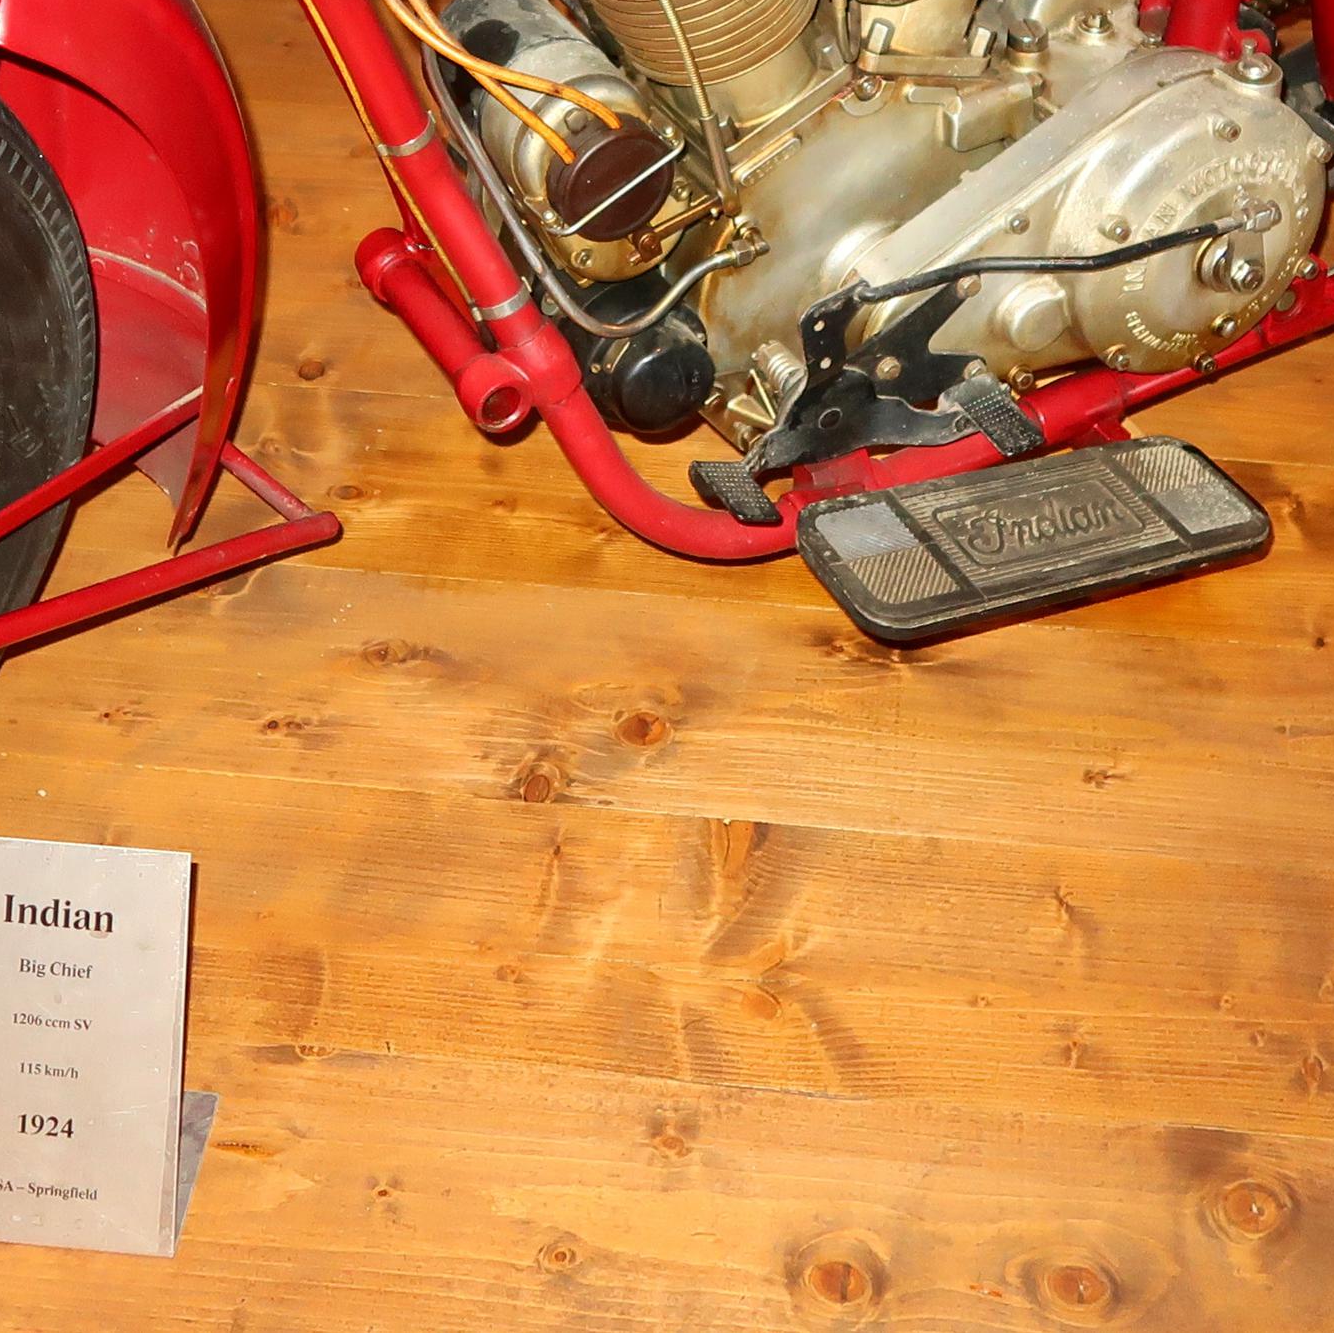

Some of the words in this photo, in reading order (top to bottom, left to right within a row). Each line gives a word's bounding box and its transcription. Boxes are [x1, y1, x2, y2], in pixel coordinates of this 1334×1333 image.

[969, 494, 1127, 555] Indian
[3, 893, 114, 933] Indian
[18, 958, 46, 979] Big
[49, 962, 93, 980] Chief
[11, 1012, 43, 1027] 1206
[44, 1018, 71, 1030] ccm
[73, 1019, 93, 1031] SV
[19, 1062, 41, 1076] 115
[43, 1063, 79, 1080] km/h
[17, 1114, 74, 1139] 1924
[27, 1181, 98, 1201] Springfield
